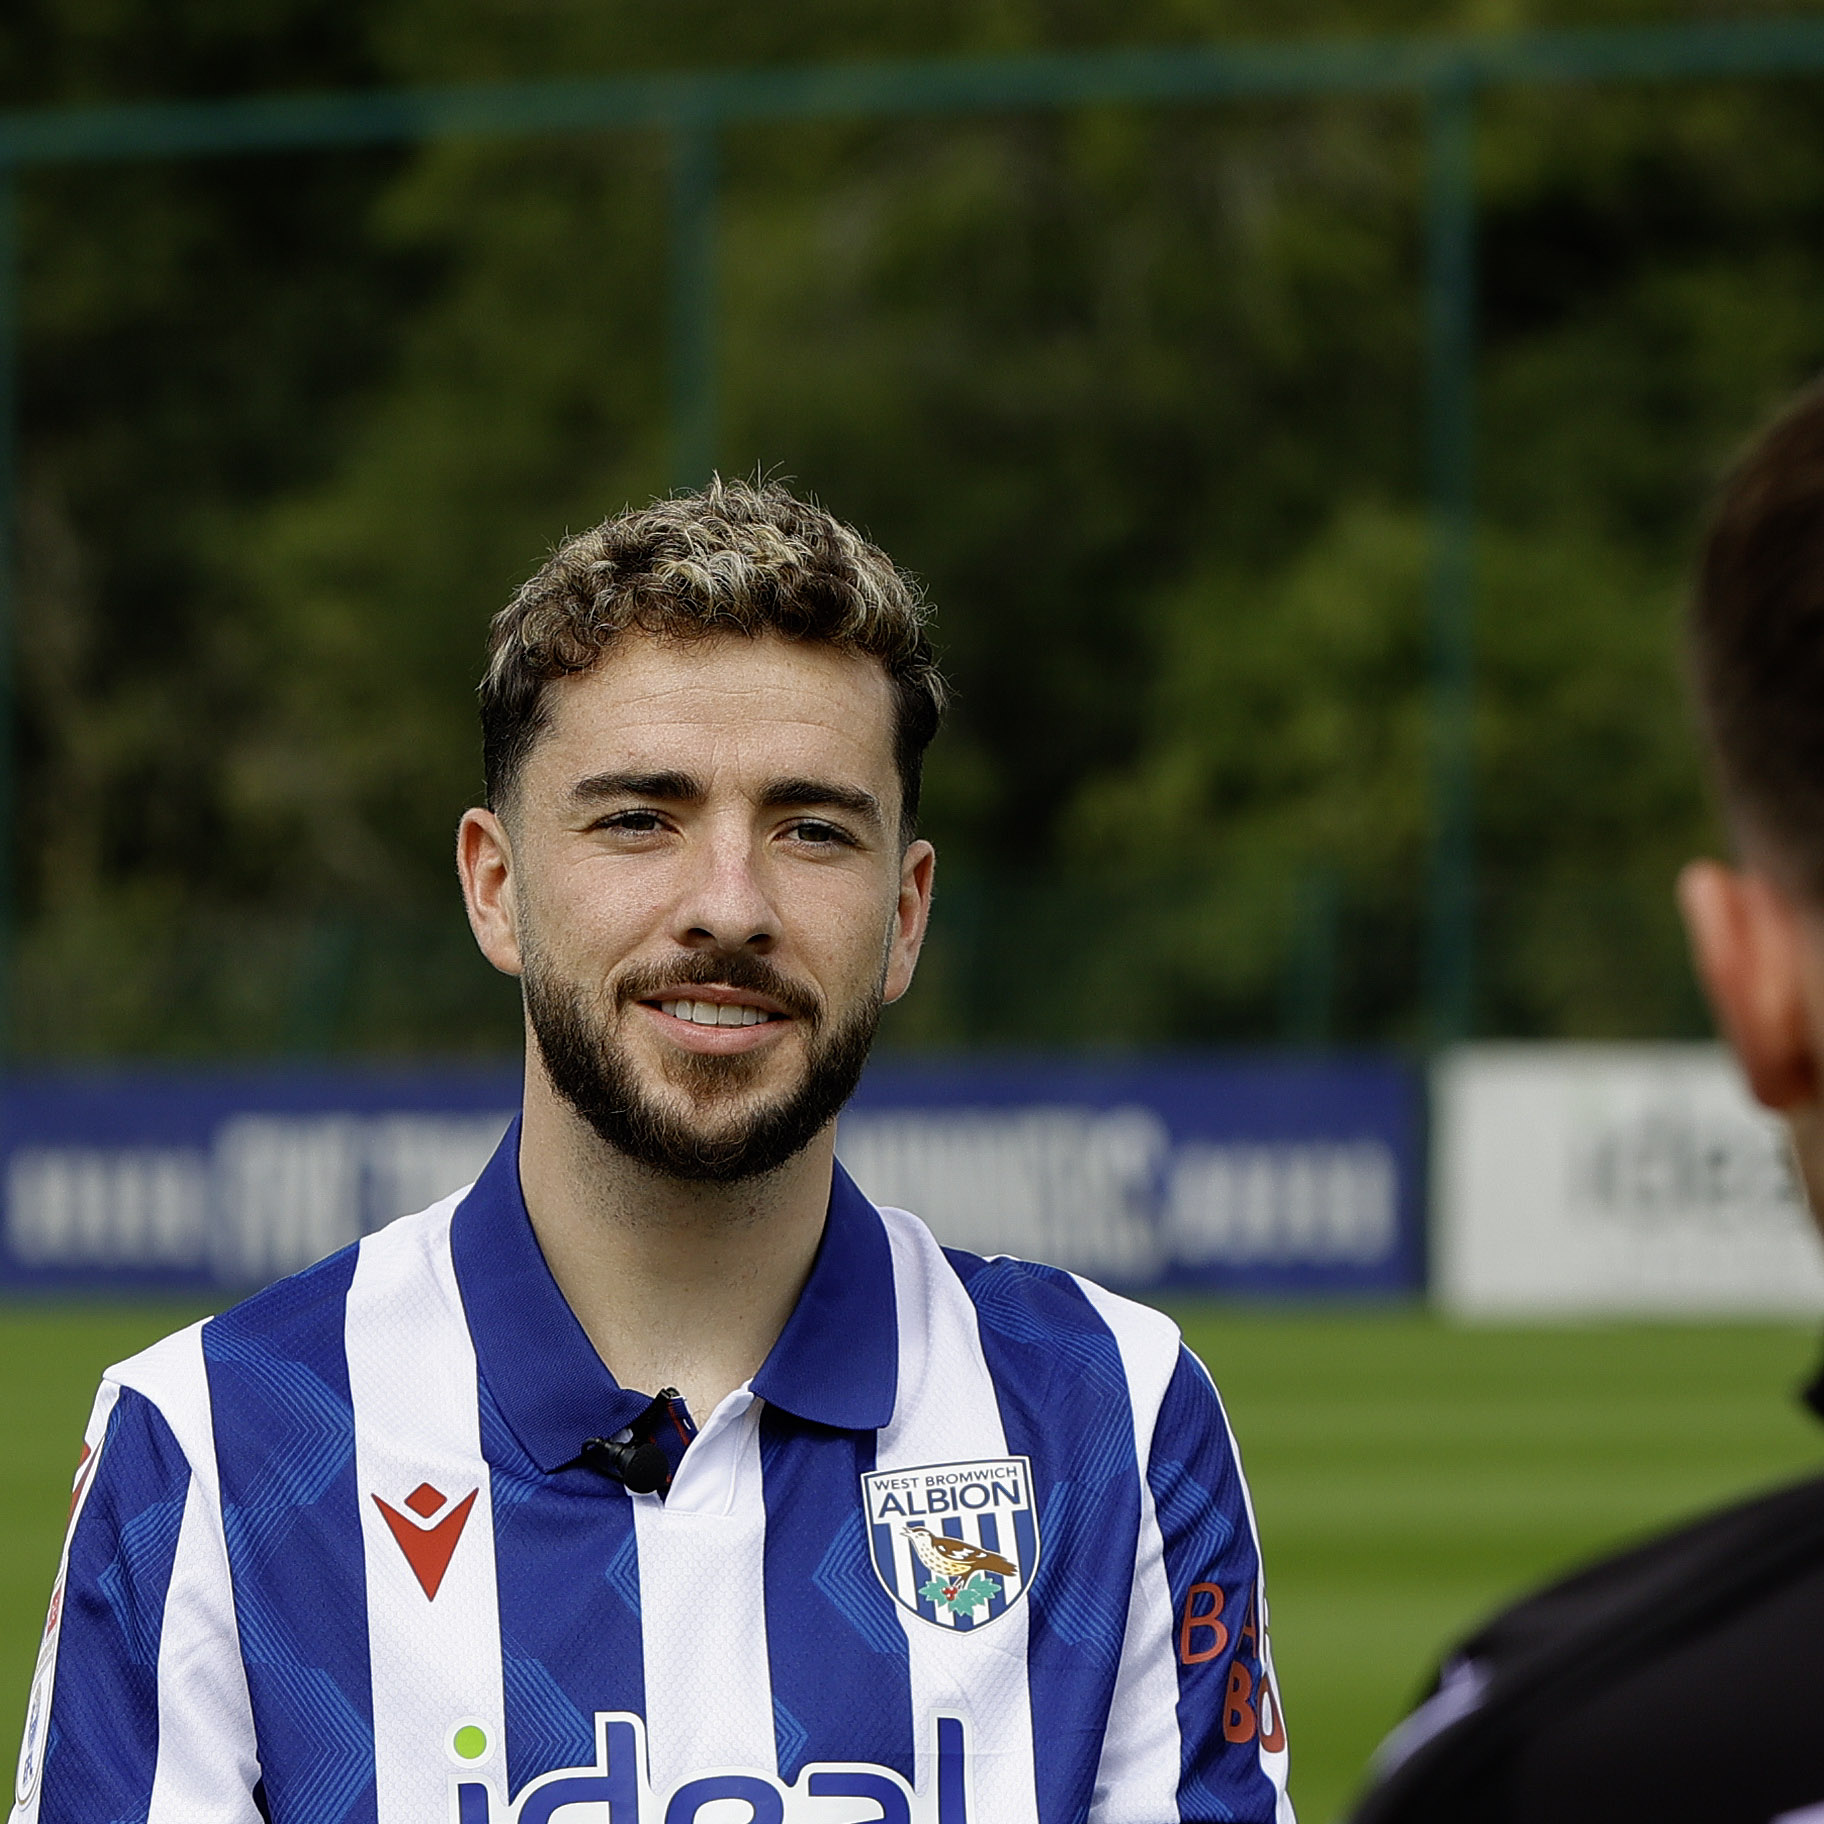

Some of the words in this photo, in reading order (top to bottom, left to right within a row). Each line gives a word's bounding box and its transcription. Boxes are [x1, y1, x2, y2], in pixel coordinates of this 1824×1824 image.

[874, 1477, 919, 1491] WEST
[926, 1466, 1018, 1486] BROMWICH
[878, 1479, 1021, 1518] ALBION
